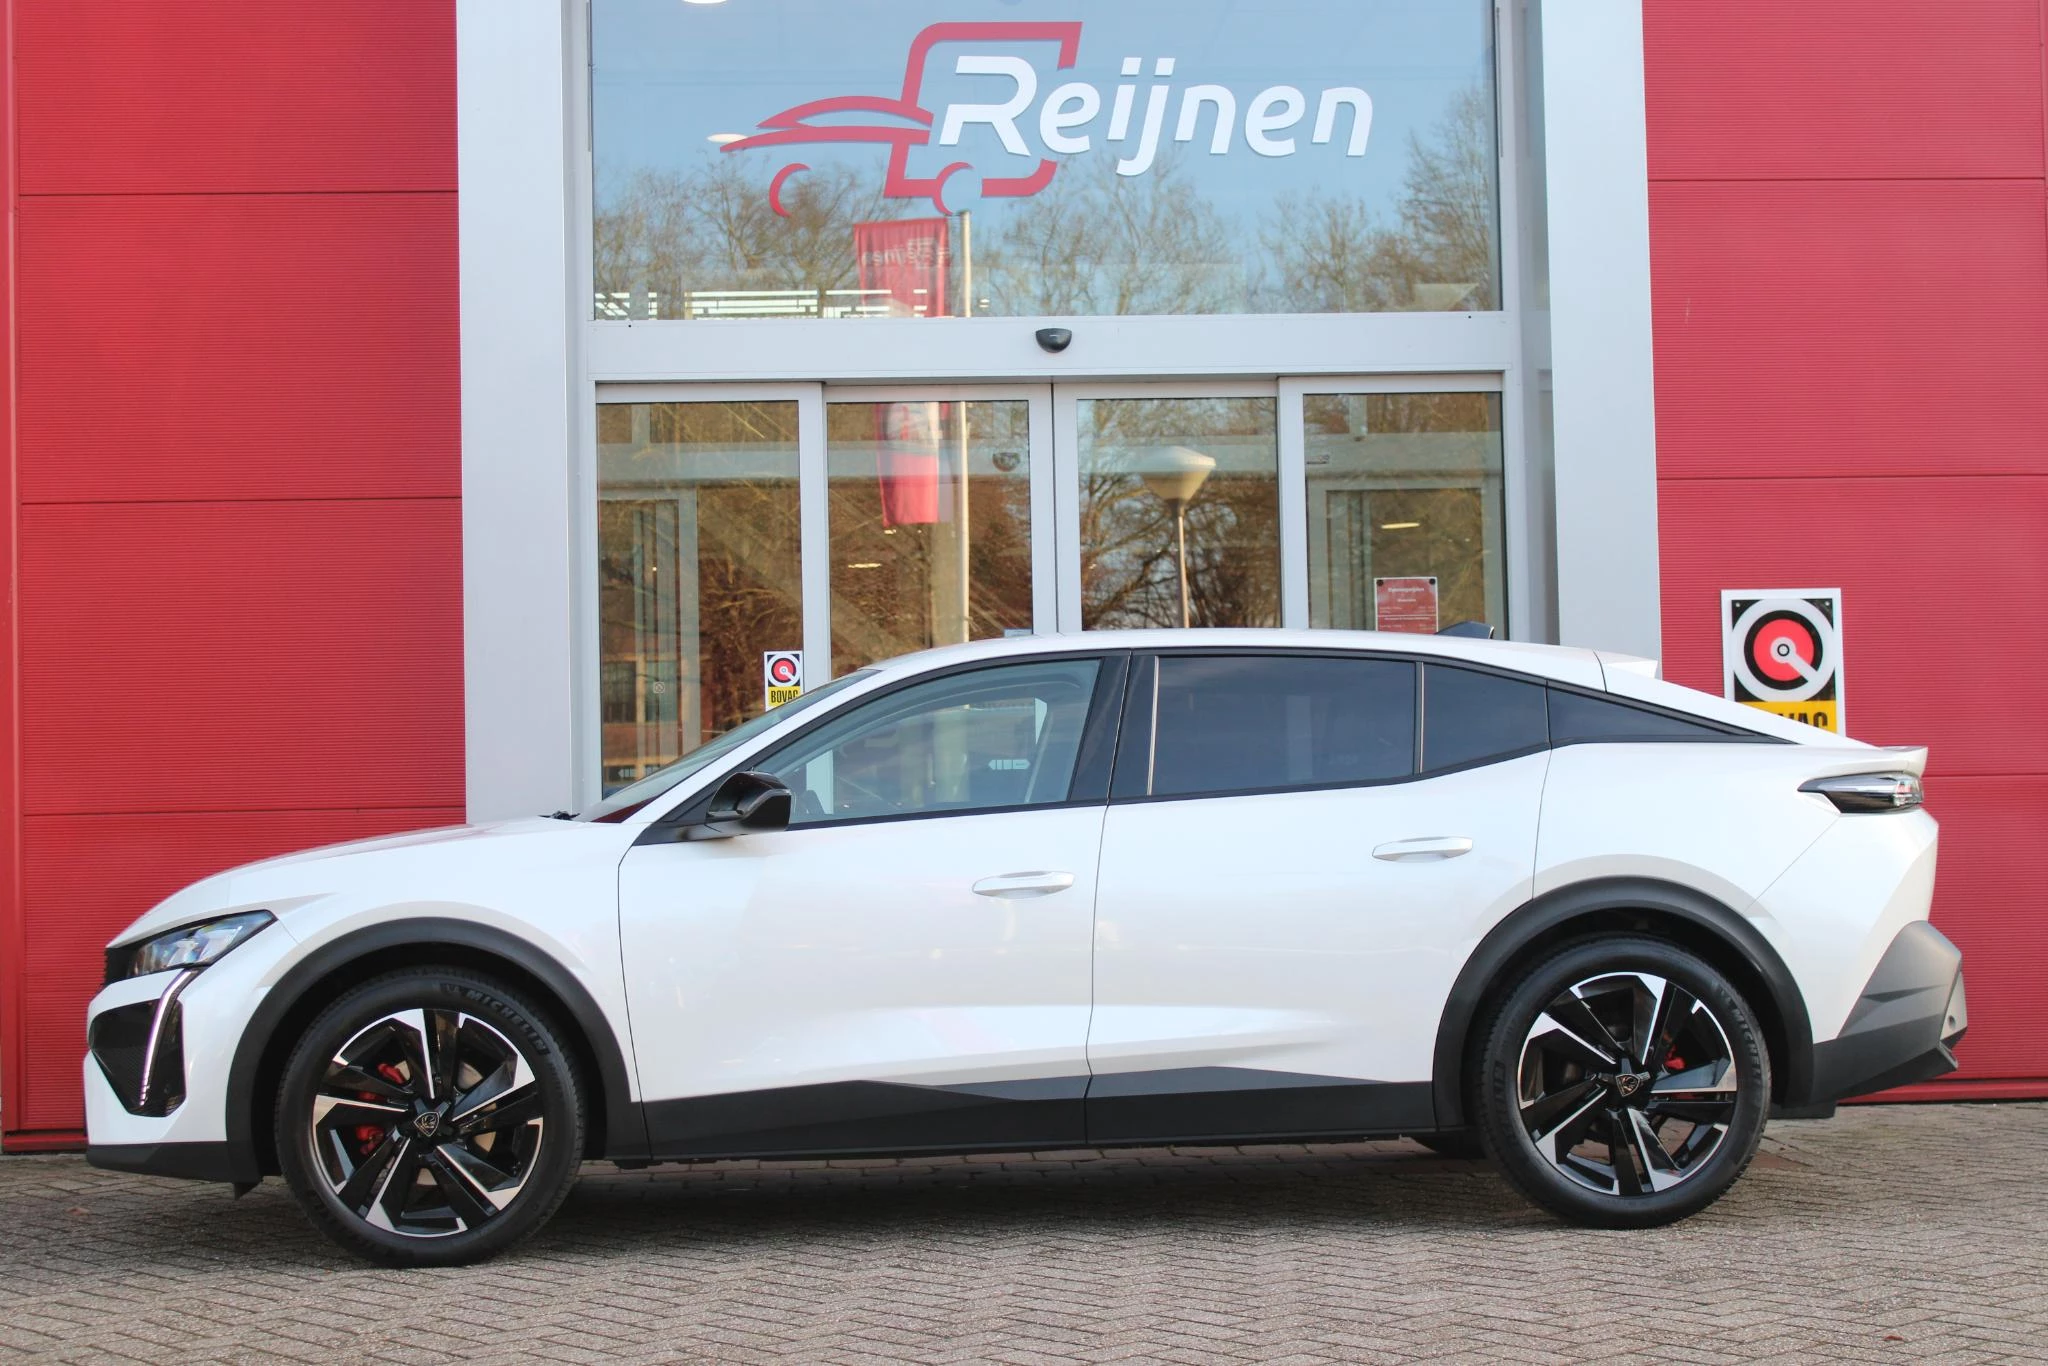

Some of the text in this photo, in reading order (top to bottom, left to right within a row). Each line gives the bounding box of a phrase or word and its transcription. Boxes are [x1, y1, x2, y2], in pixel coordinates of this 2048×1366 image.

[939, 56, 1373, 176] Reijnen
[466, 989, 548, 1053] MICHELIN
[1731, 1007, 1763, 1095] MICHEL
